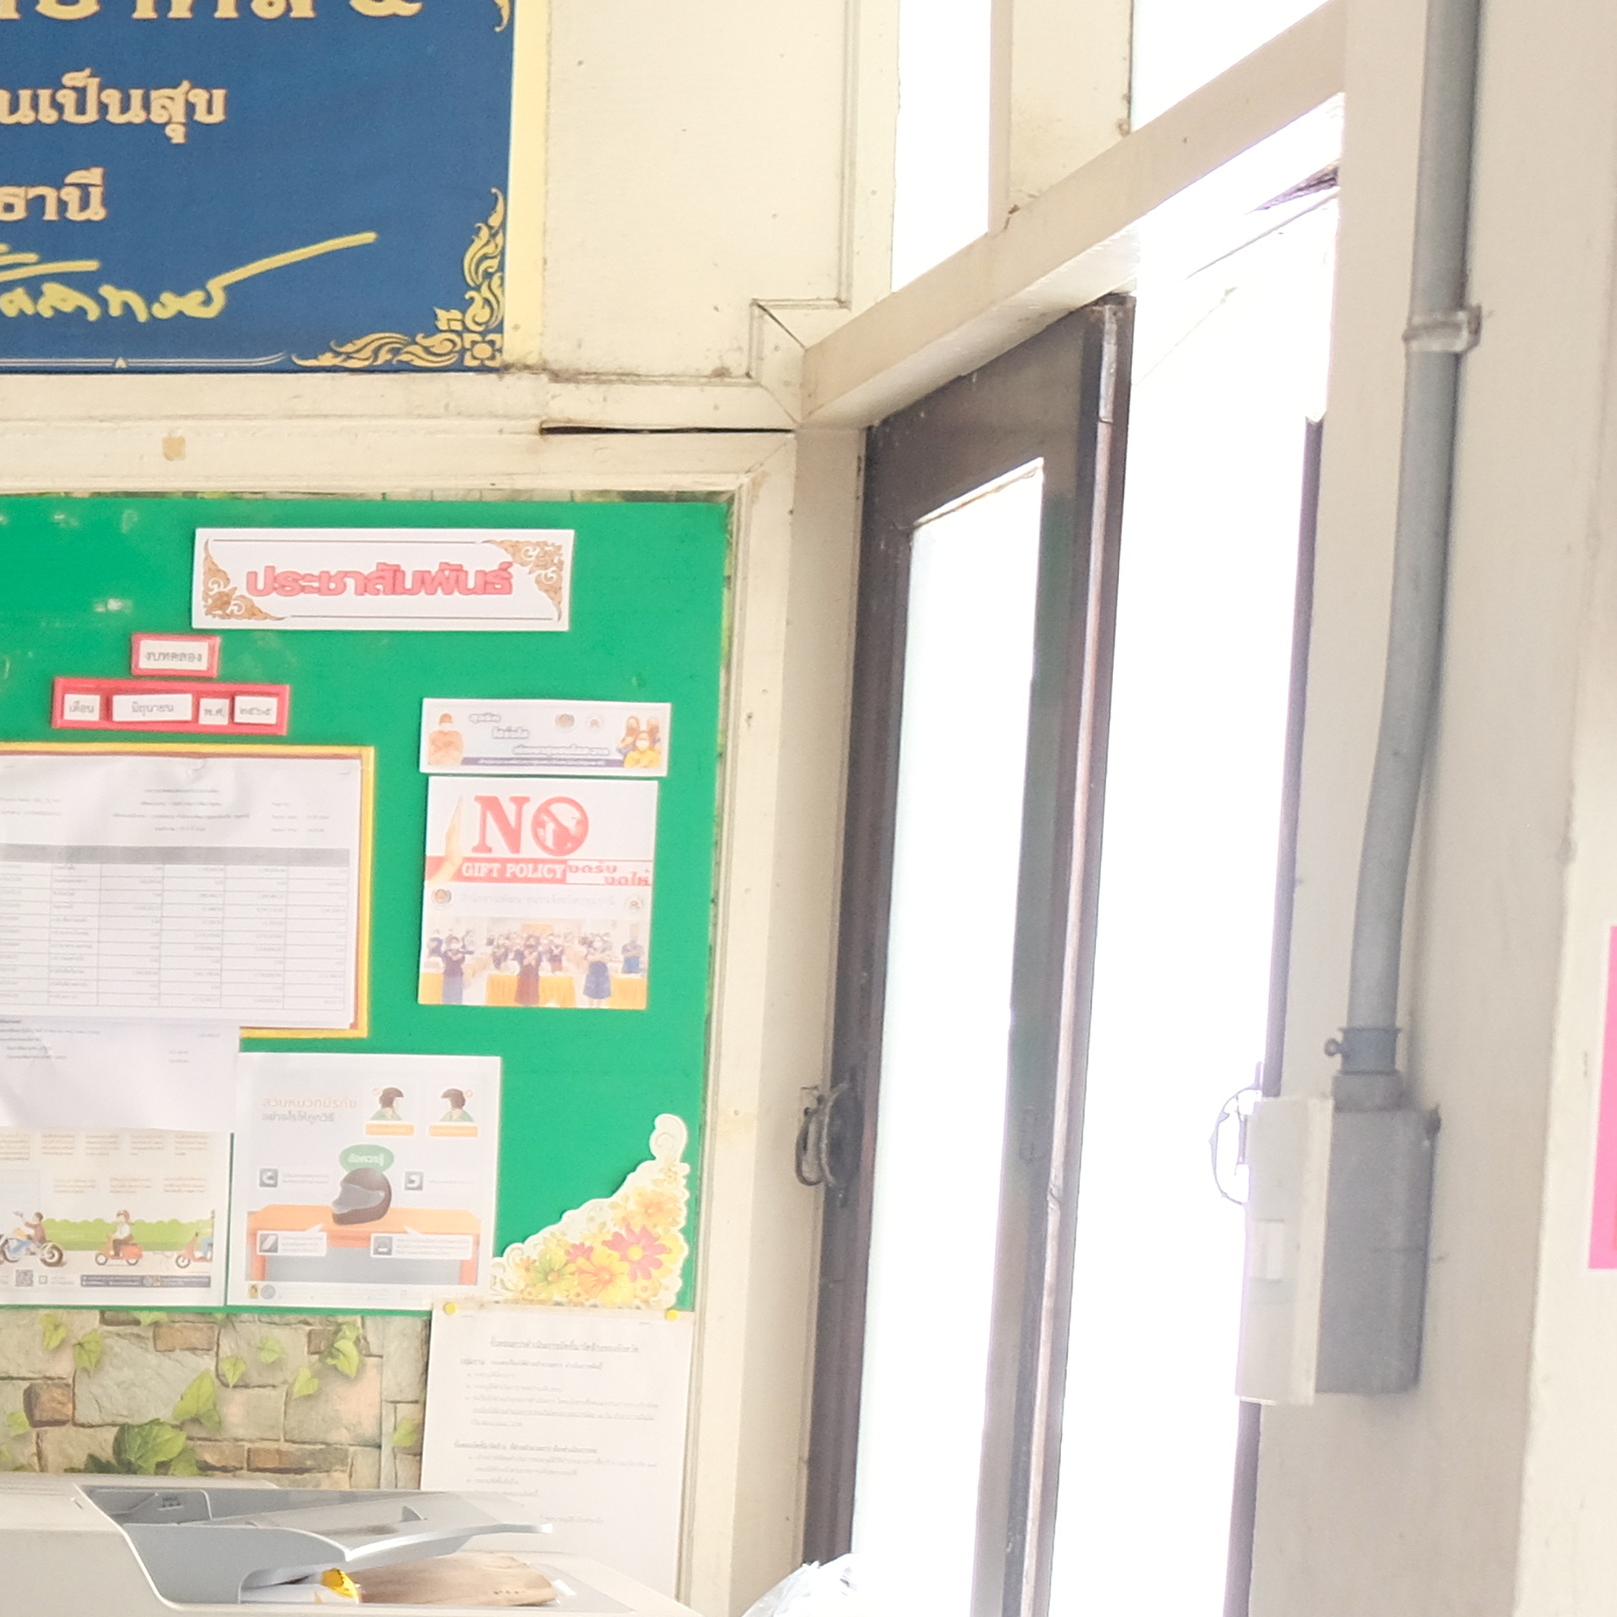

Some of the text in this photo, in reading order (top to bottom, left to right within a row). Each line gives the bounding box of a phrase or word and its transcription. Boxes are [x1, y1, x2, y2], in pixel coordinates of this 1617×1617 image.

[246, 561, 514, 597] ประชาสัมพันธ์
[68, 701, 95, 714] เดือน
[462, 862, 566, 879] GIFT POLICY
